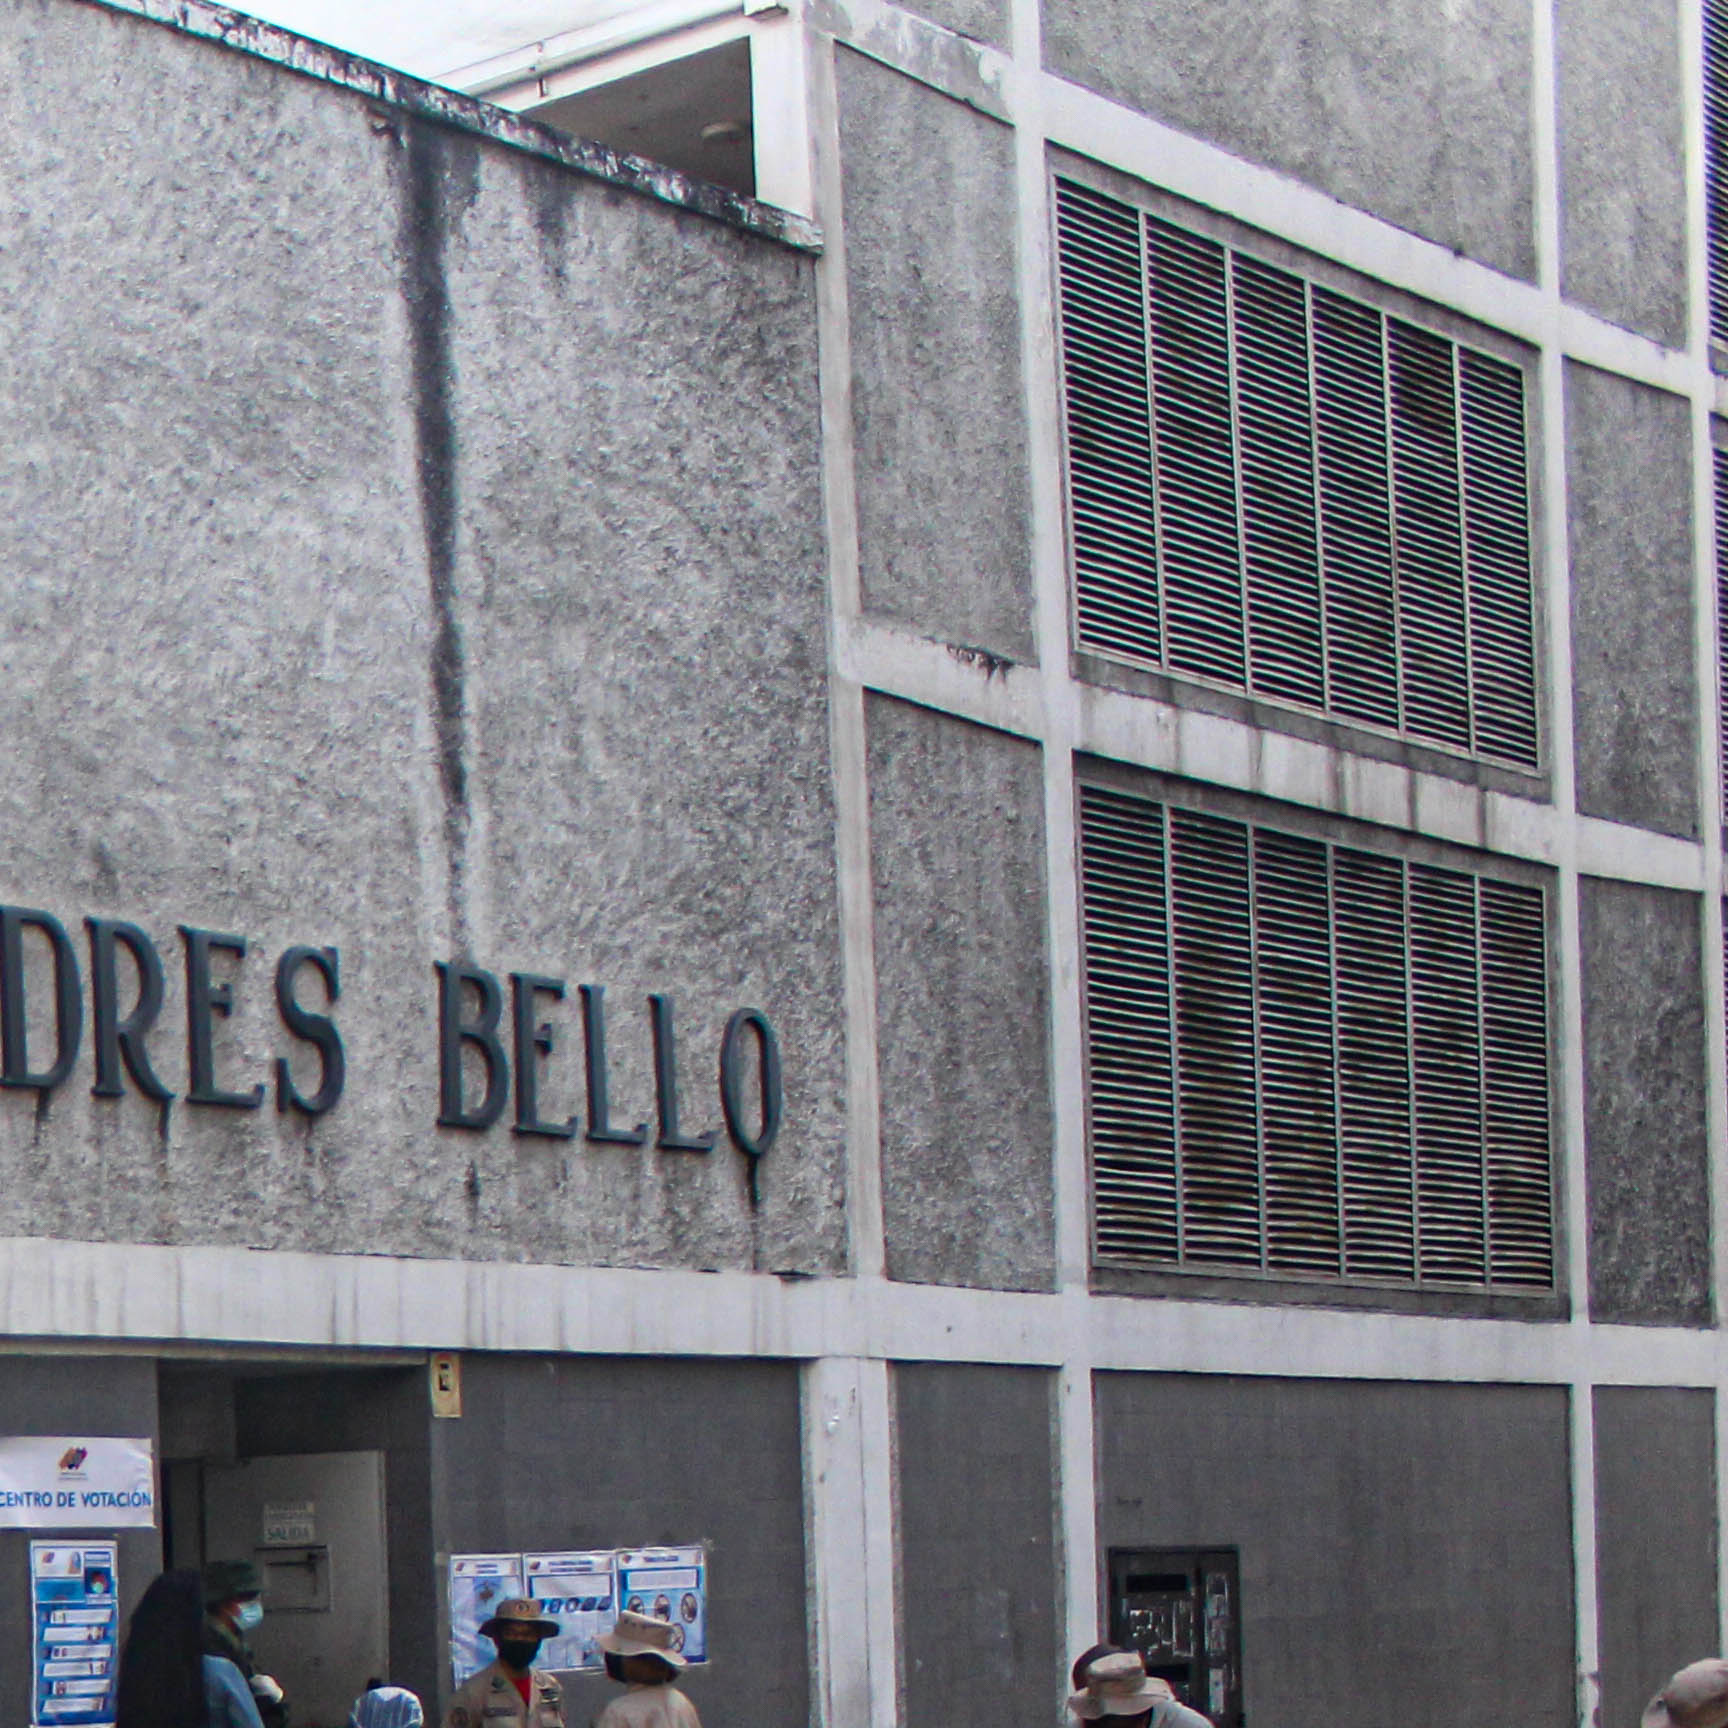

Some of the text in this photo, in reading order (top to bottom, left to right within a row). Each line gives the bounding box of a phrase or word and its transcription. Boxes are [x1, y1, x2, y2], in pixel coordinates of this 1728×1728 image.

[432, 960, 782, 1156] BELLO
[57, 1491, 77, 1508] DE
[81, 1488, 152, 1508] VOTACIÓN
